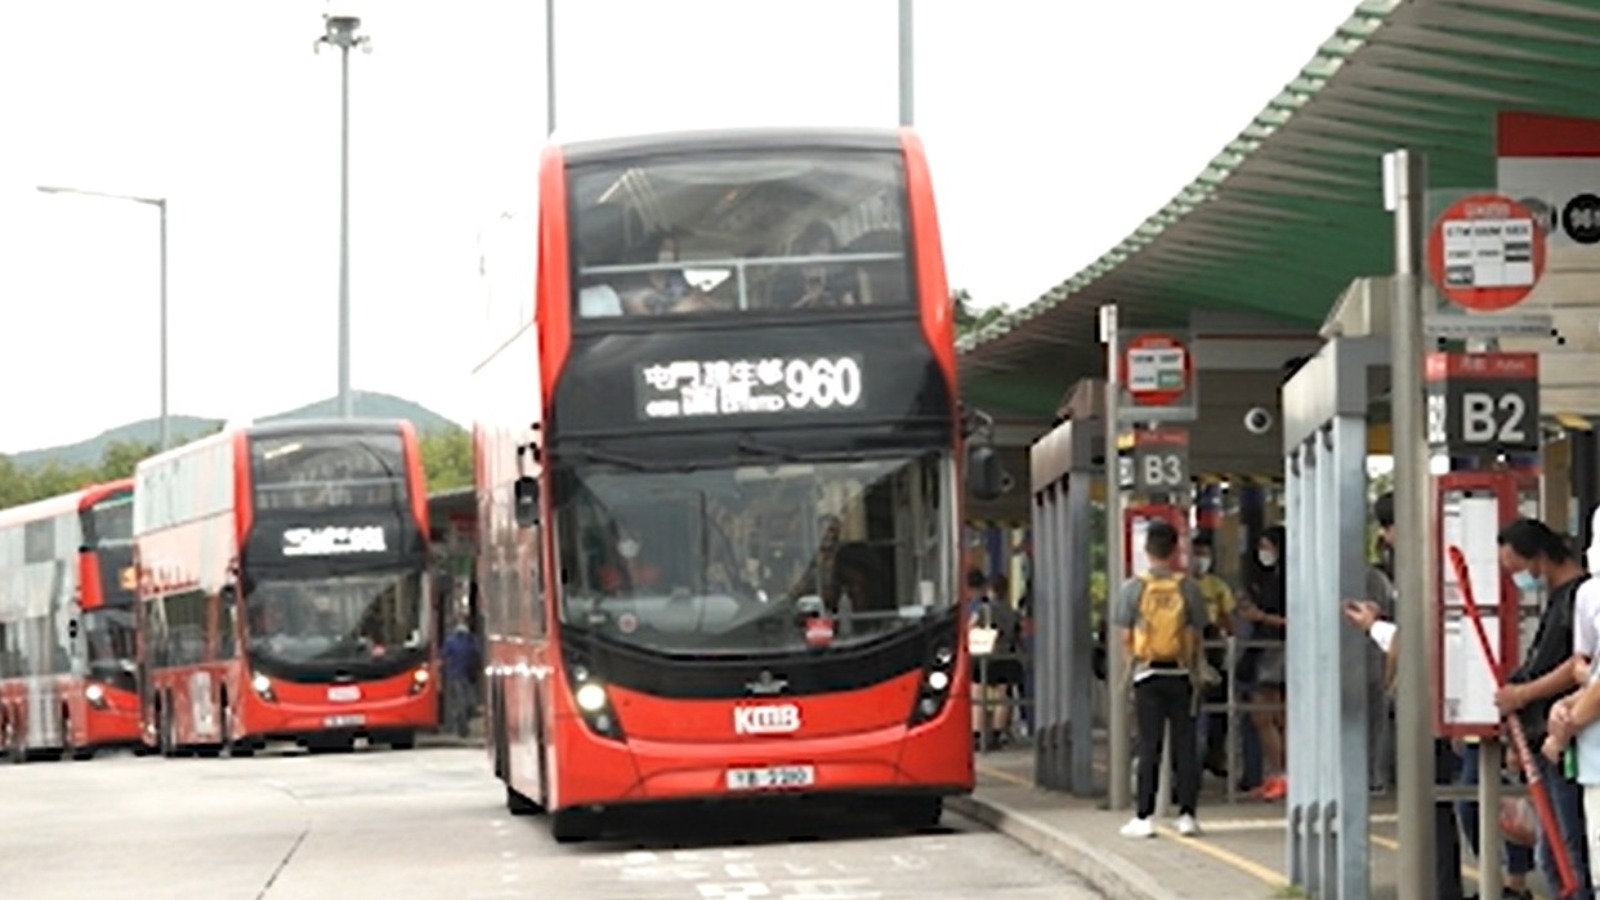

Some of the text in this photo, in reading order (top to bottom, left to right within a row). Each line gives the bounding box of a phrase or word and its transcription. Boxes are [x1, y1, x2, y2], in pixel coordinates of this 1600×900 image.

[785, 357, 861, 408] 960
[1463, 393, 1525, 442] B2
[1144, 454, 1183, 485] B3
[734, 705, 800, 734] KMB
